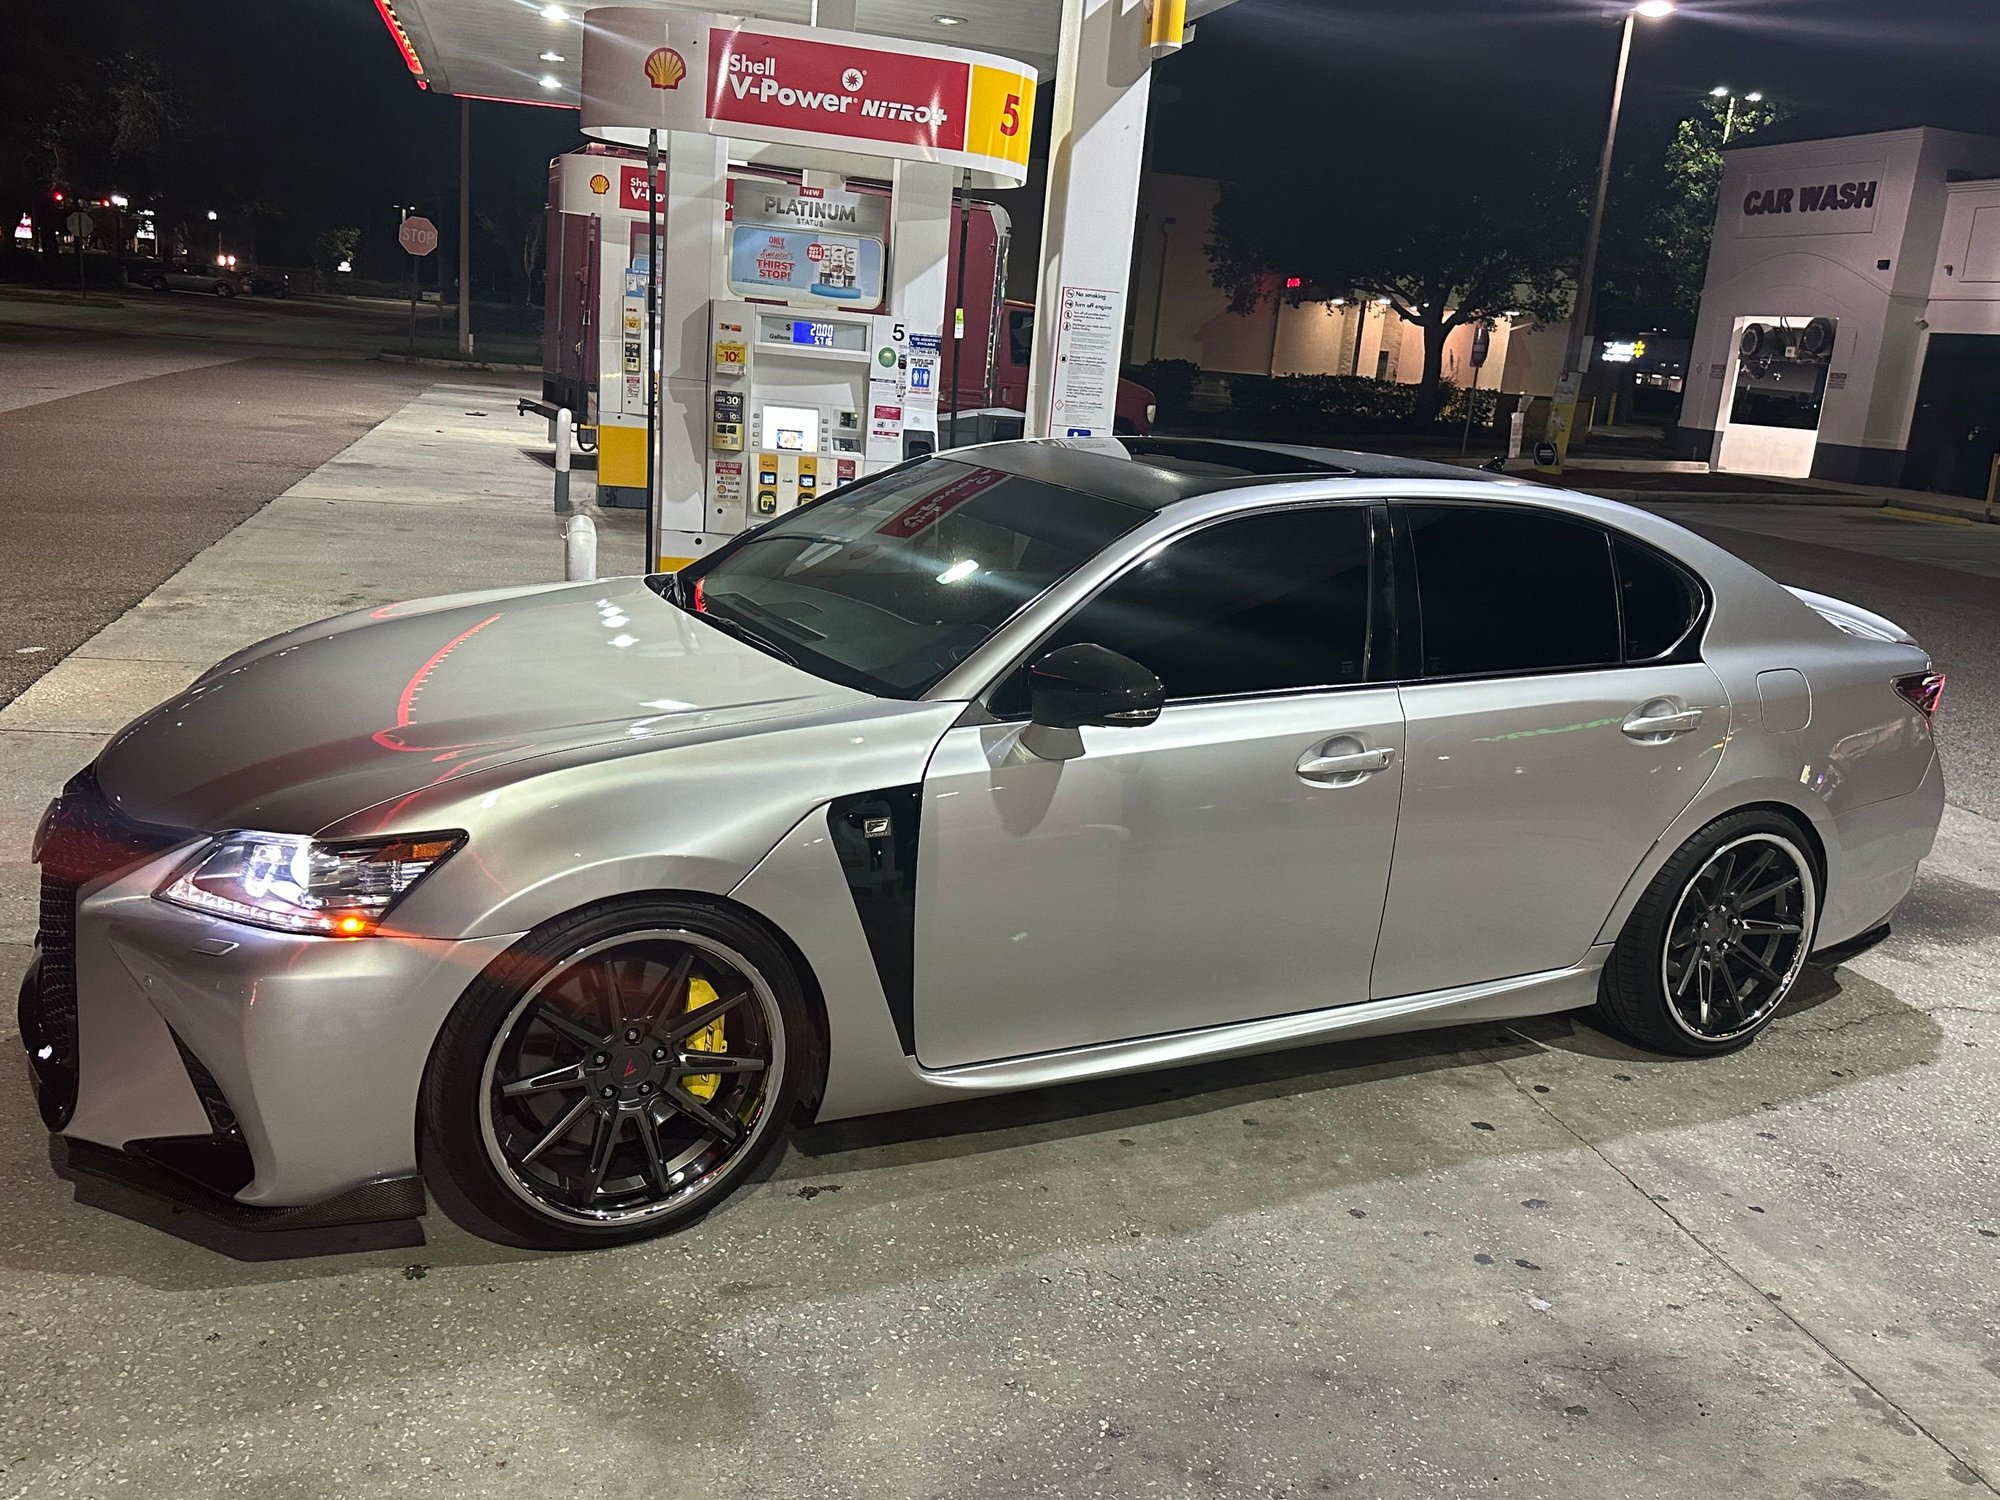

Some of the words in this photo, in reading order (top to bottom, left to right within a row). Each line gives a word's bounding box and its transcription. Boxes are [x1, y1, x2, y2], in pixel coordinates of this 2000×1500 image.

[728, 53, 776, 77] Shell
[730, 74, 854, 113] V-Power
[999, 93, 1021, 137] 5
[630, 177, 650, 189] She
[803, 188, 821, 197] NEW
[1743, 187, 1794, 216] CAR
[1799, 180, 1877, 213] WASH
[764, 196, 856, 224] PLATINUM
[796, 217, 824, 228] STATUS
[402, 227, 436, 245] STOP
[768, 235, 785, 248] ONLY
[756, 259, 795, 271] THIRST
[759, 270, 792, 282] STOP!
[1085, 293, 1107, 301] smoking
[785, 323, 791, 331] $
[892, 323, 905, 342] 5
[769, 333, 791, 341] Gallons
